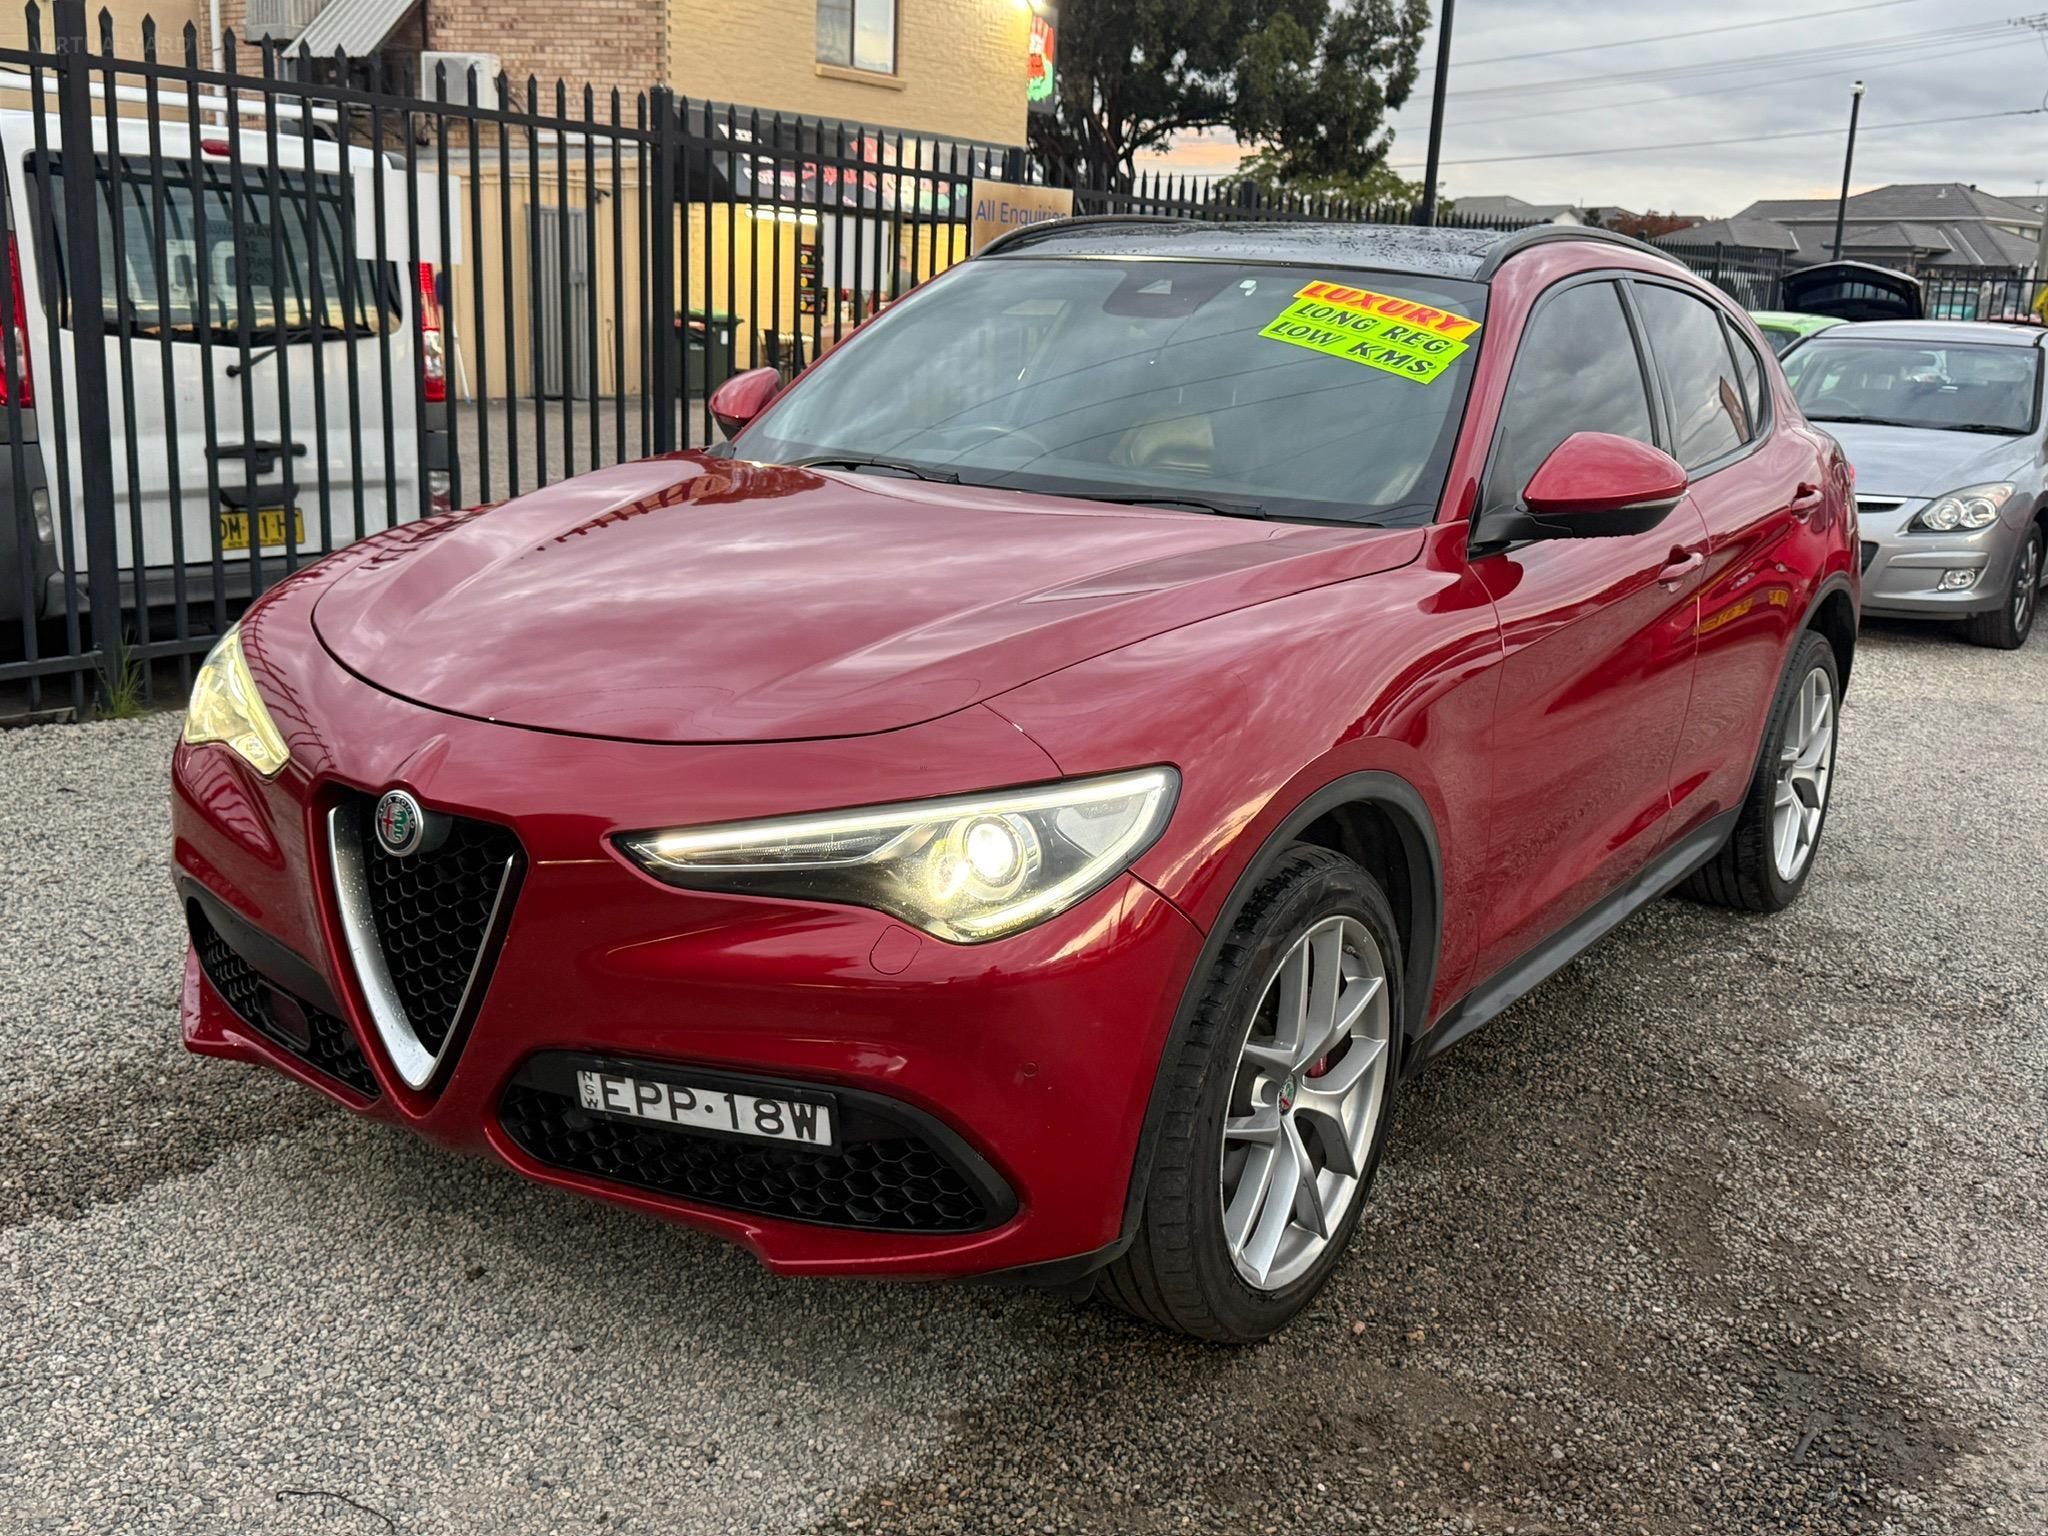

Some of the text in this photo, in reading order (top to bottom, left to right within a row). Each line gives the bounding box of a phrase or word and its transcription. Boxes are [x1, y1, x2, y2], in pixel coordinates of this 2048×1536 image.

[975, 199, 996, 222] All
[1294, 302, 1453, 355] LONG REG
[1301, 283, 1473, 331] LUXURY
[1269, 320, 1437, 376] LOW KMS
